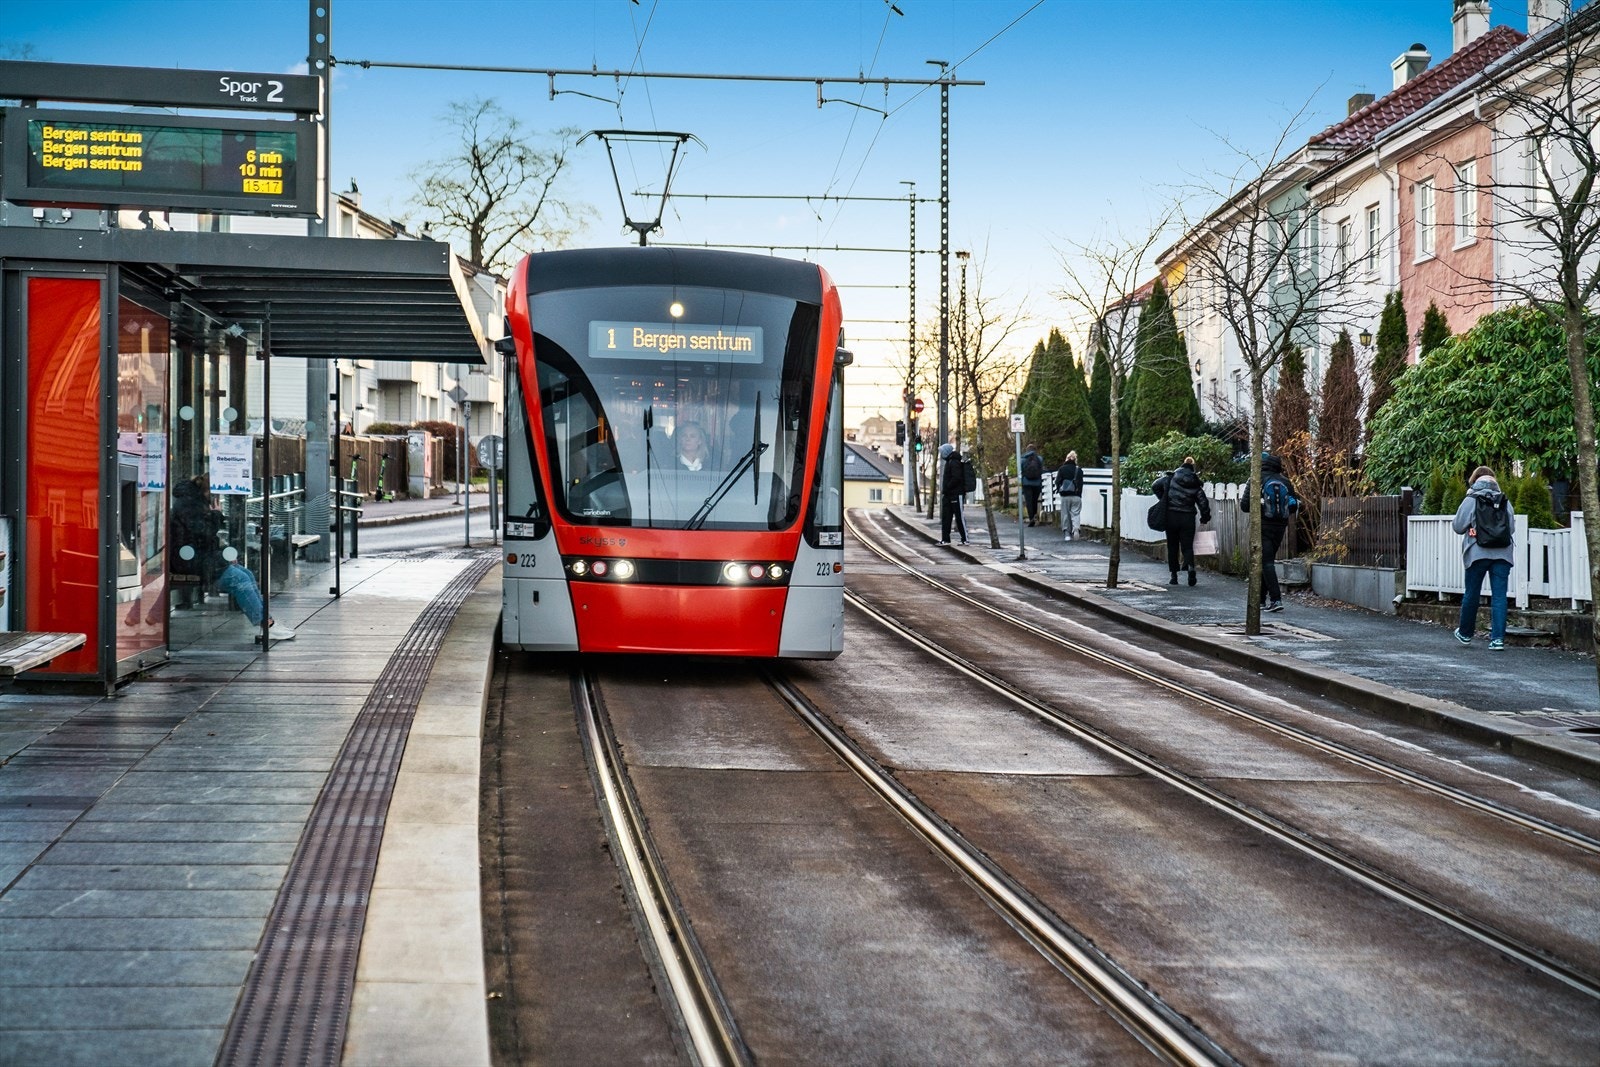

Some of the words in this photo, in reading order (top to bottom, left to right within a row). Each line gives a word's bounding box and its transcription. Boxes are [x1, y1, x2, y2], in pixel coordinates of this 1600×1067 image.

[219, 76, 262, 97] Spor
[266, 80, 284, 103] 2
[239, 94, 258, 103] Track
[42, 126, 88, 143] Bergen
[89, 130, 142, 143] sentrum
[42, 140, 88, 157] Bergen
[89, 144, 142, 157] sentrum
[42, 154, 88, 171] Bergen
[89, 158, 142, 171] sentrum
[246, 149, 257, 163] 6
[259, 151, 283, 164] min
[239, 163, 257, 177] 10
[259, 165, 283, 178] min
[245, 180, 280, 193] 15:17
[607, 328, 617, 349] 1
[632, 327, 686, 353] Bergen
[689, 330, 752, 352] sentrum
[520, 553, 536, 568] 223
[816, 562, 831, 576] 223
